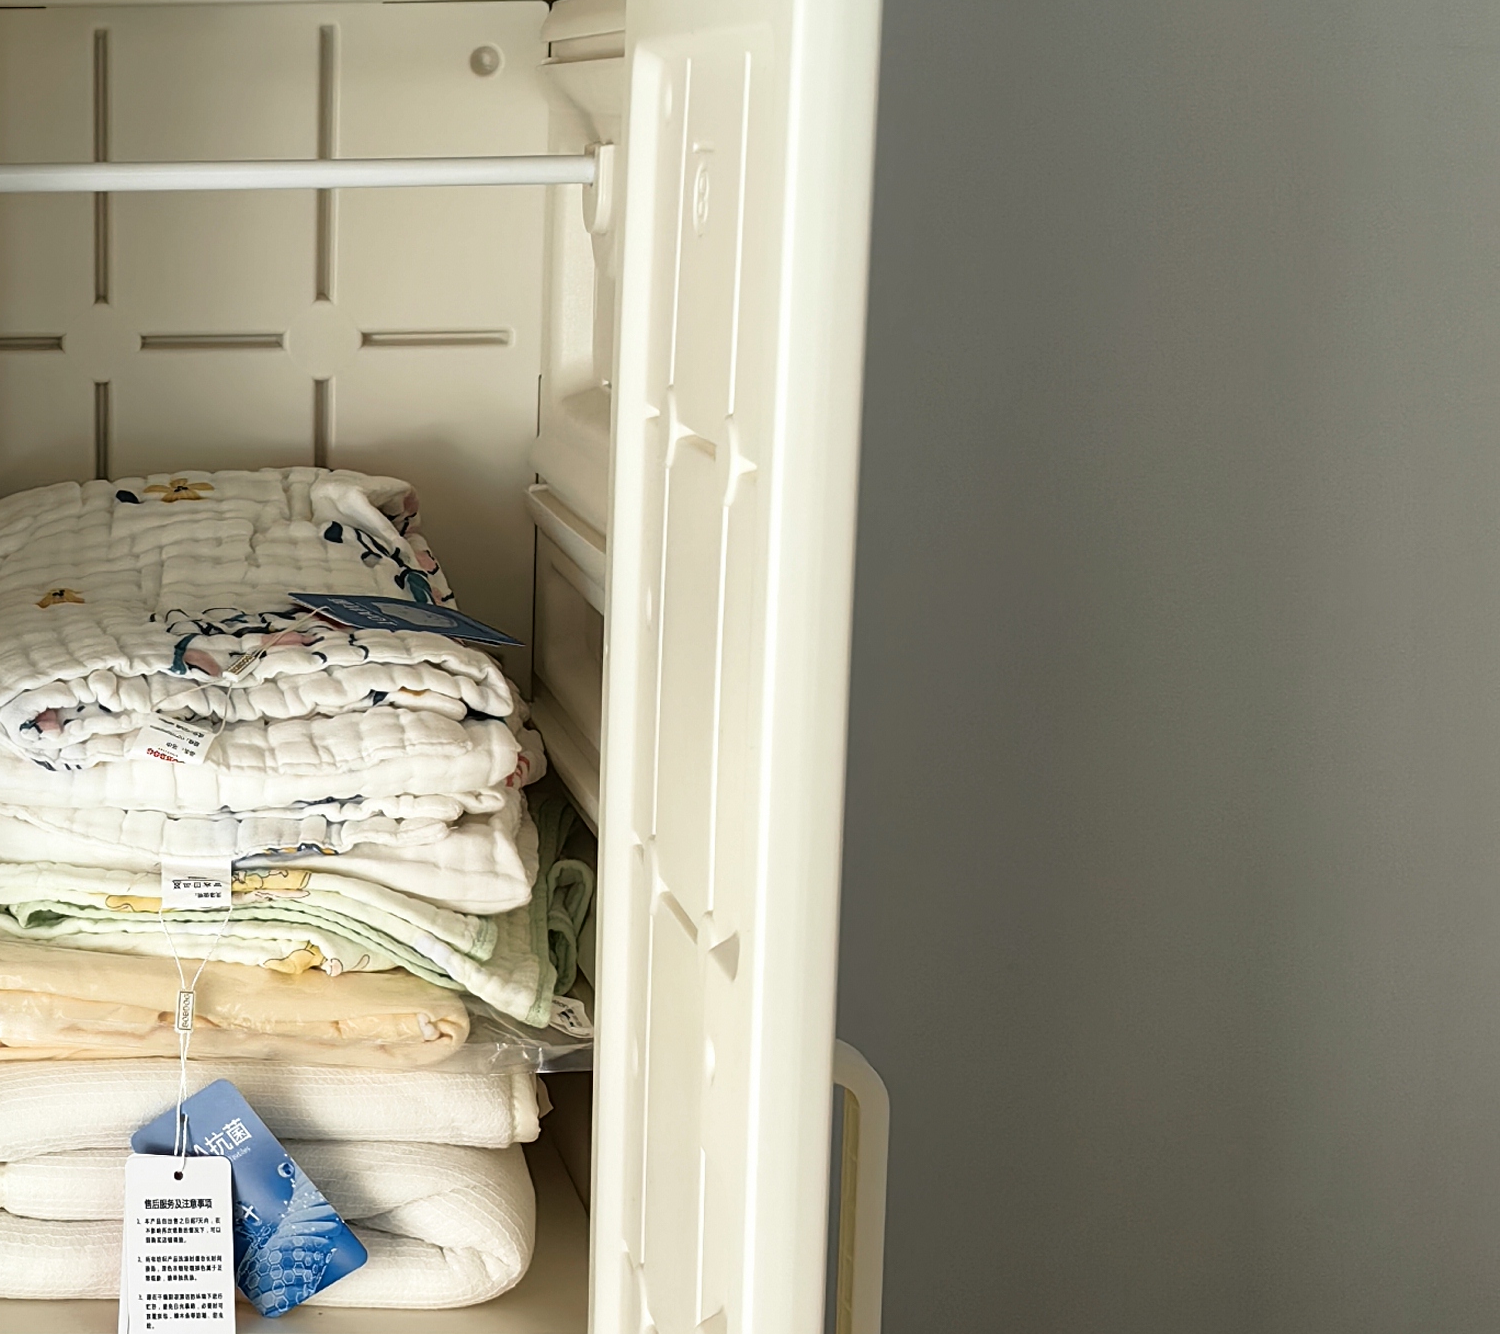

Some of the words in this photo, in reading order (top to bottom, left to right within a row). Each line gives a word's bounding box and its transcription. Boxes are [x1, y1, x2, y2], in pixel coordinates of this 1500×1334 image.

[144, 1198, 212, 1209] 售后服务及注意事项
